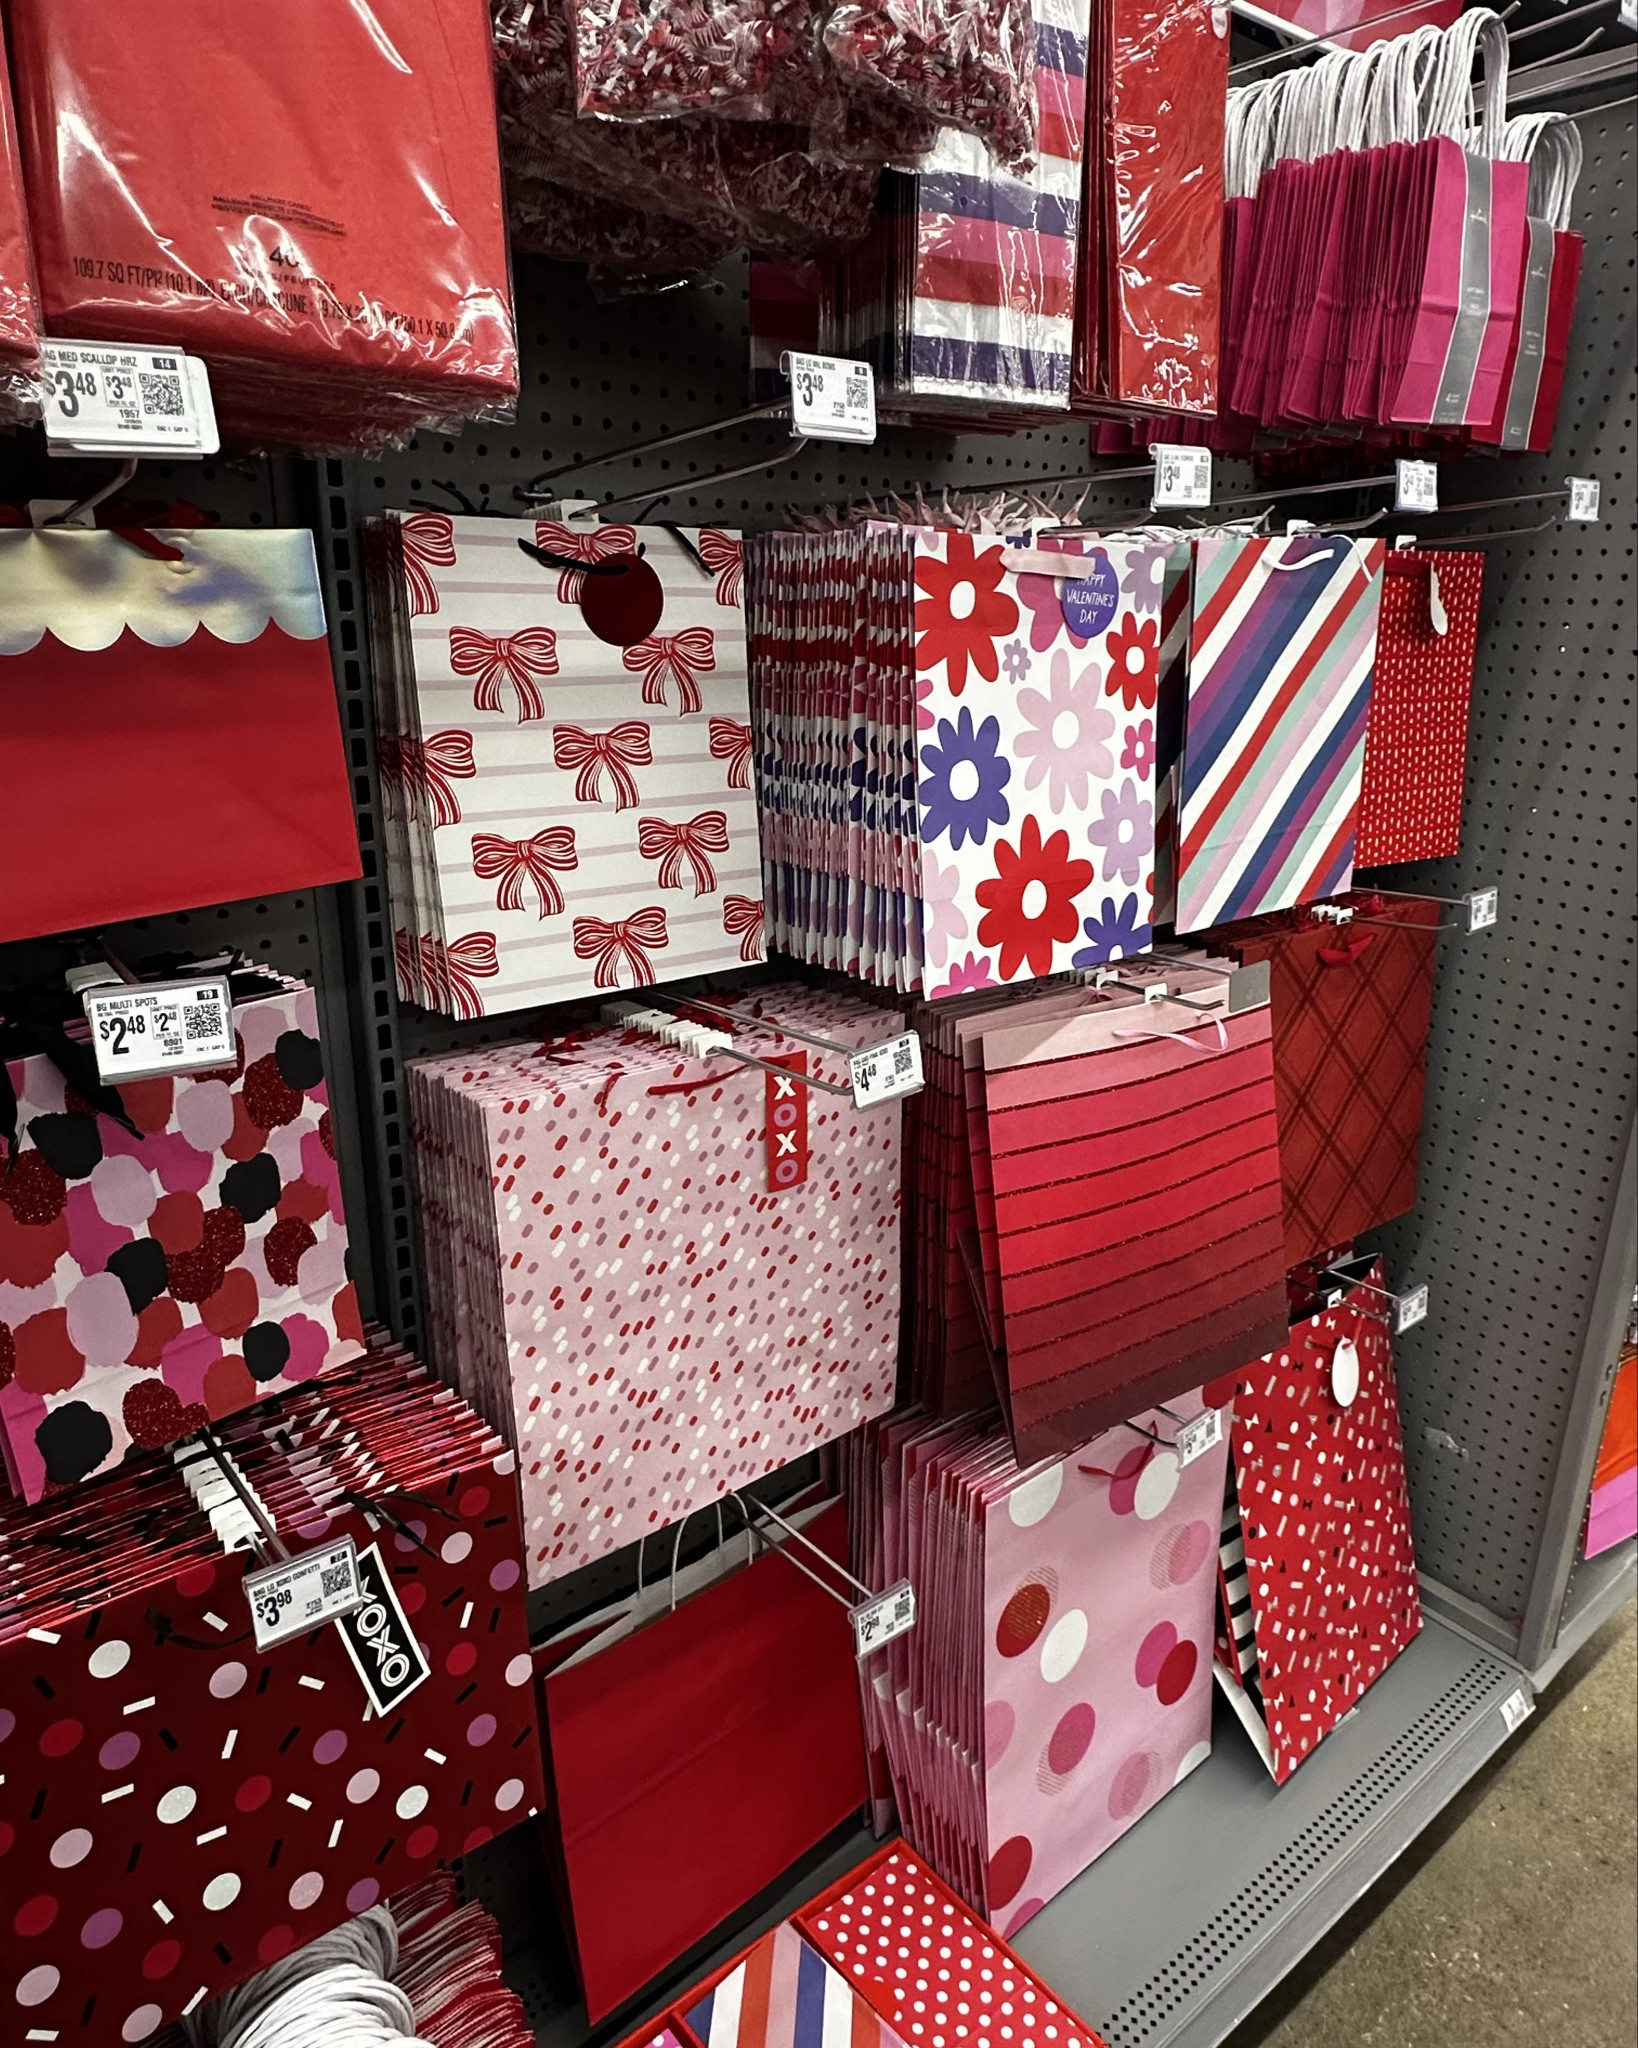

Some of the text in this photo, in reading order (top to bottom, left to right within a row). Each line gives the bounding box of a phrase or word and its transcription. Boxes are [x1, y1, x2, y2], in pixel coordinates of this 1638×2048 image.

[73, 257, 104, 279] 109.7
[107, 261, 124, 284] SQ
[426, 318, 434, 336] X
[58, 351, 78, 362] MED
[80, 353, 118, 365] SCALLOP
[120, 356, 137, 367] HRZ
[159, 359, 171, 369] 14
[1079, 608, 1099, 624] DAY
[202, 990, 214, 999] 19
[96, 996, 158, 1012] BG MULTI SPOTS
[773, 1075, 799, 1184] XOXO
[292, 1562, 320, 1580] CONFETTI
